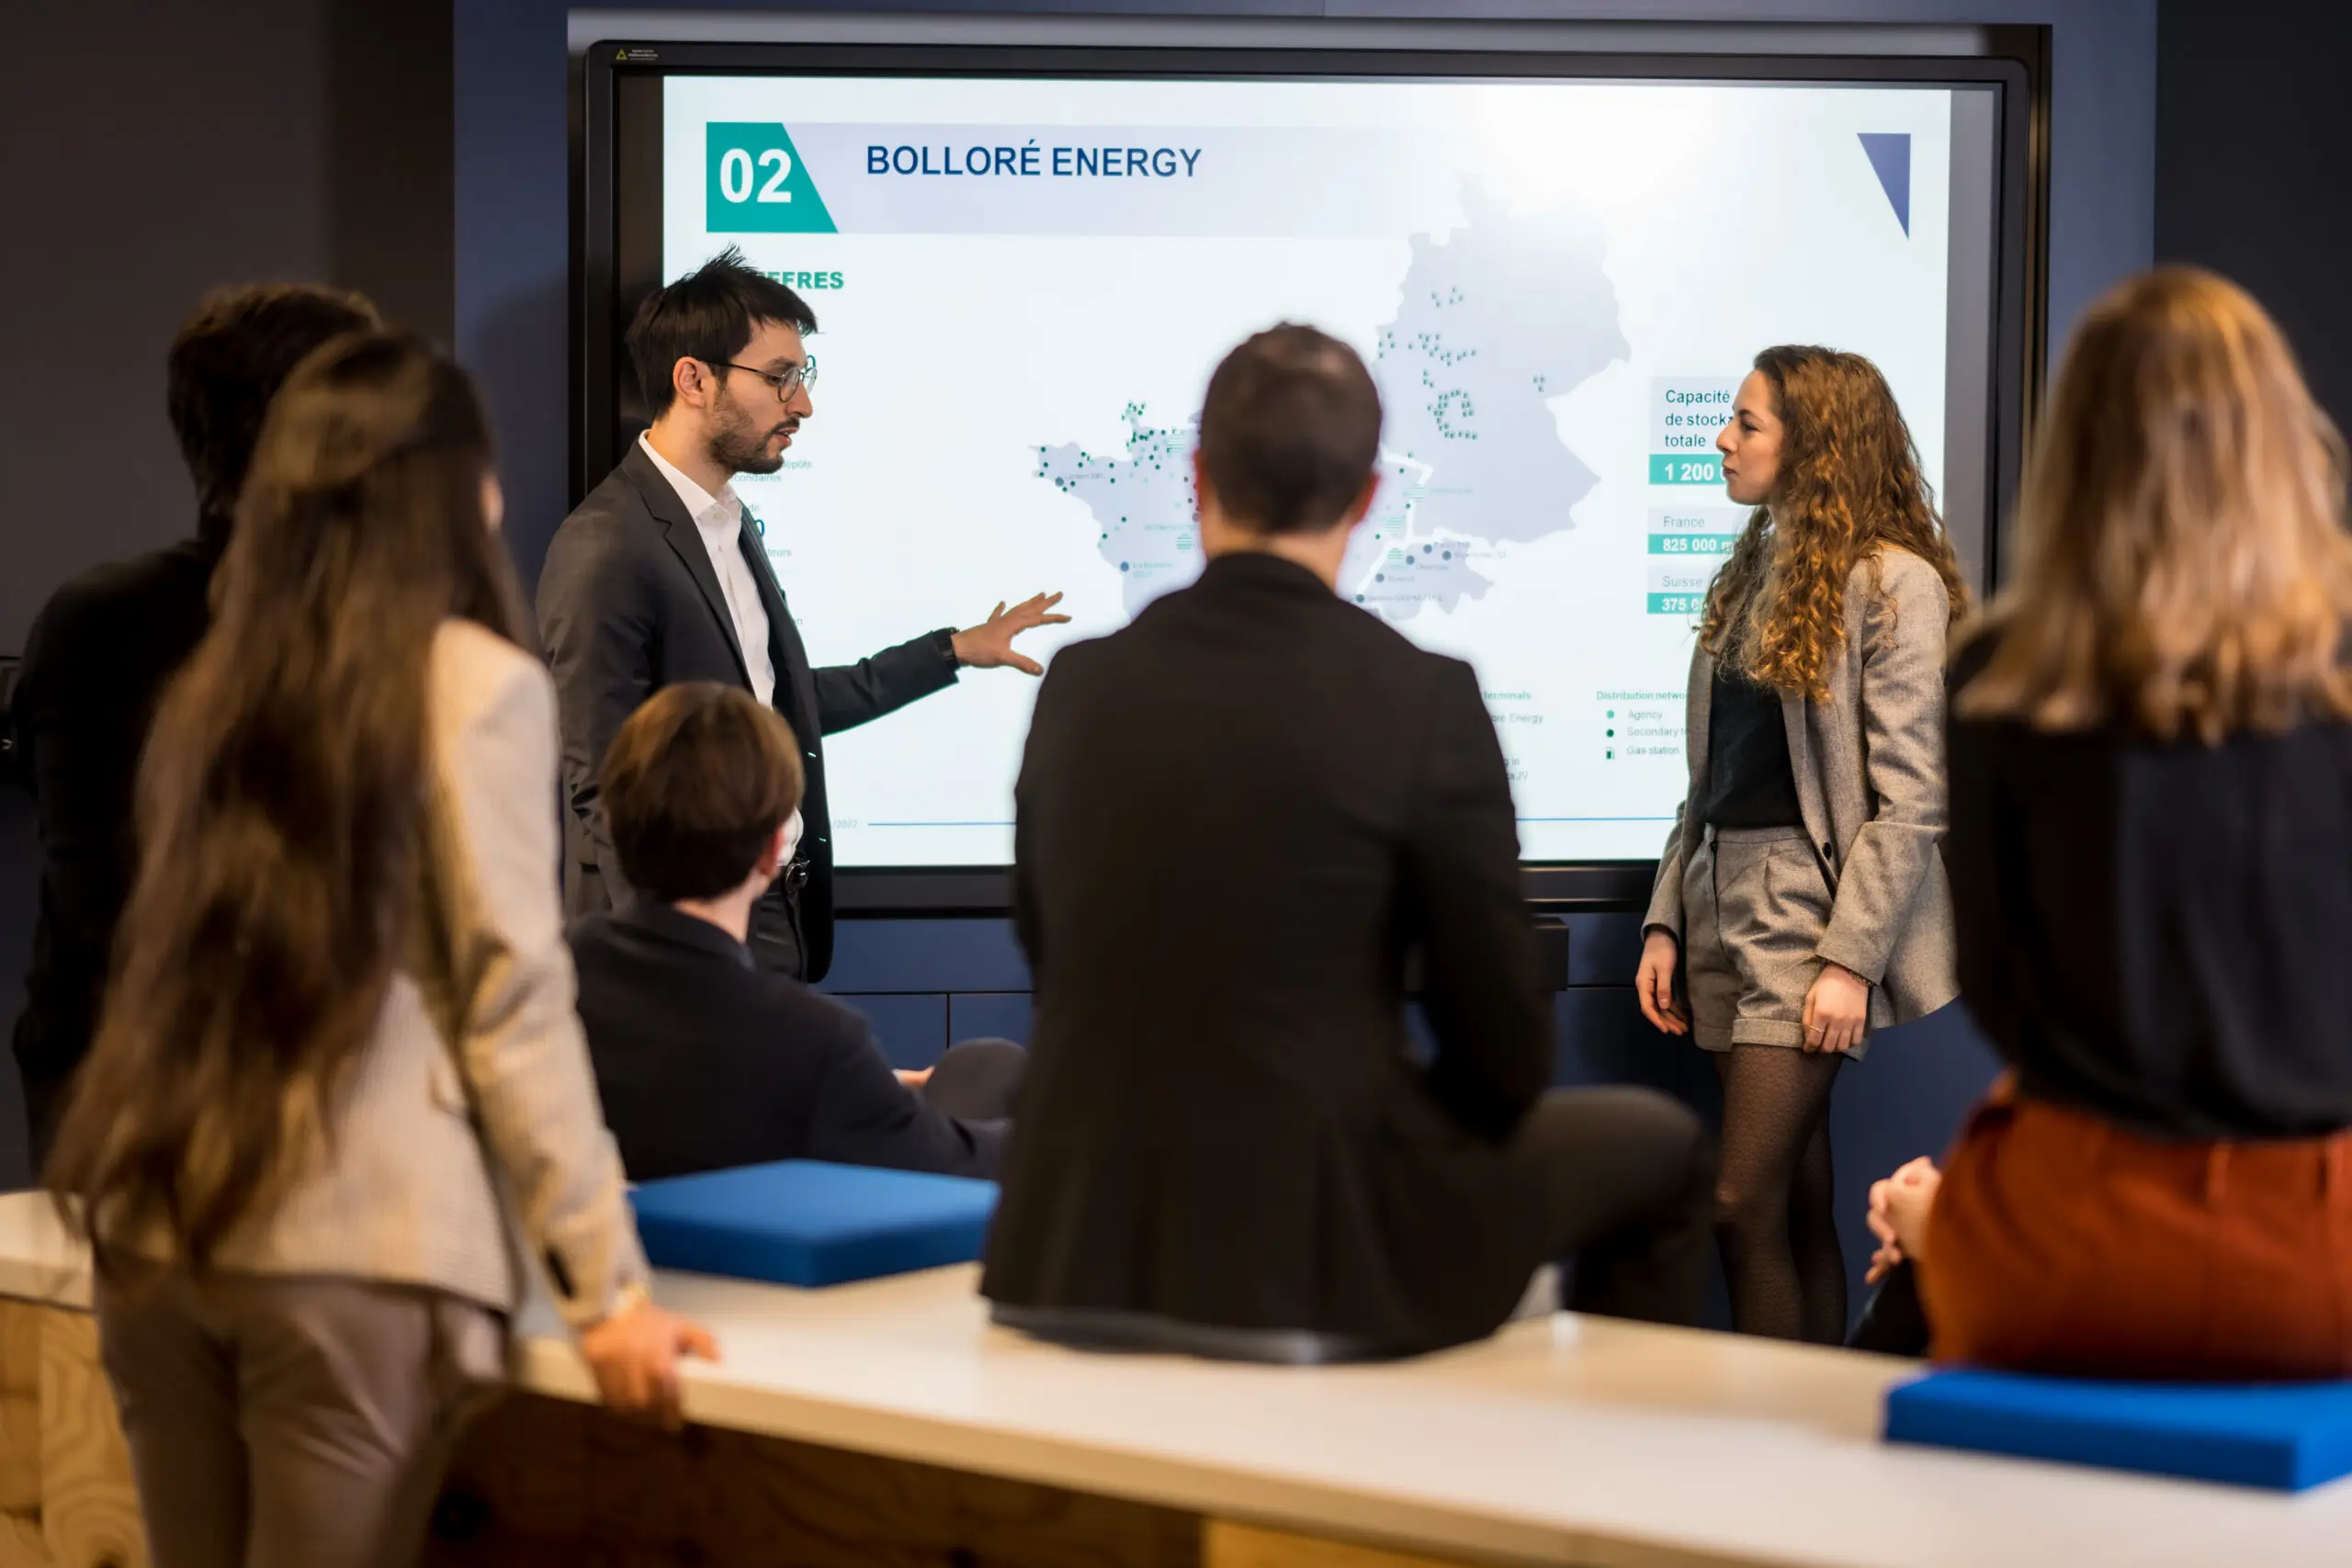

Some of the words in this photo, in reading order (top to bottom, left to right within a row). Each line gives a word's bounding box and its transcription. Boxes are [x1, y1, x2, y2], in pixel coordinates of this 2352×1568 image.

[867, 139, 1041, 175] BOLLORÉ
[1053, 147, 1202, 177] ENERGY
[719, 148, 792, 204] 02
[1665, 389, 1730, 406] Capacité
[1665, 412, 1683, 426] de
[1664, 434, 1706, 447] totale
[1665, 463, 1674, 480] 1
[1680, 463, 1714, 481] 200
[1663, 516, 1705, 528] France
[1663, 538, 1688, 551] 825
[1691, 538, 1717, 551] 000
[1662, 575, 1703, 587] Suisse
[1661, 598, 1687, 612] 375
[1596, 691, 1654, 700] Distribution
[1628, 710, 1663, 720] Agency
[1627, 727, 1679, 737] Secondary
